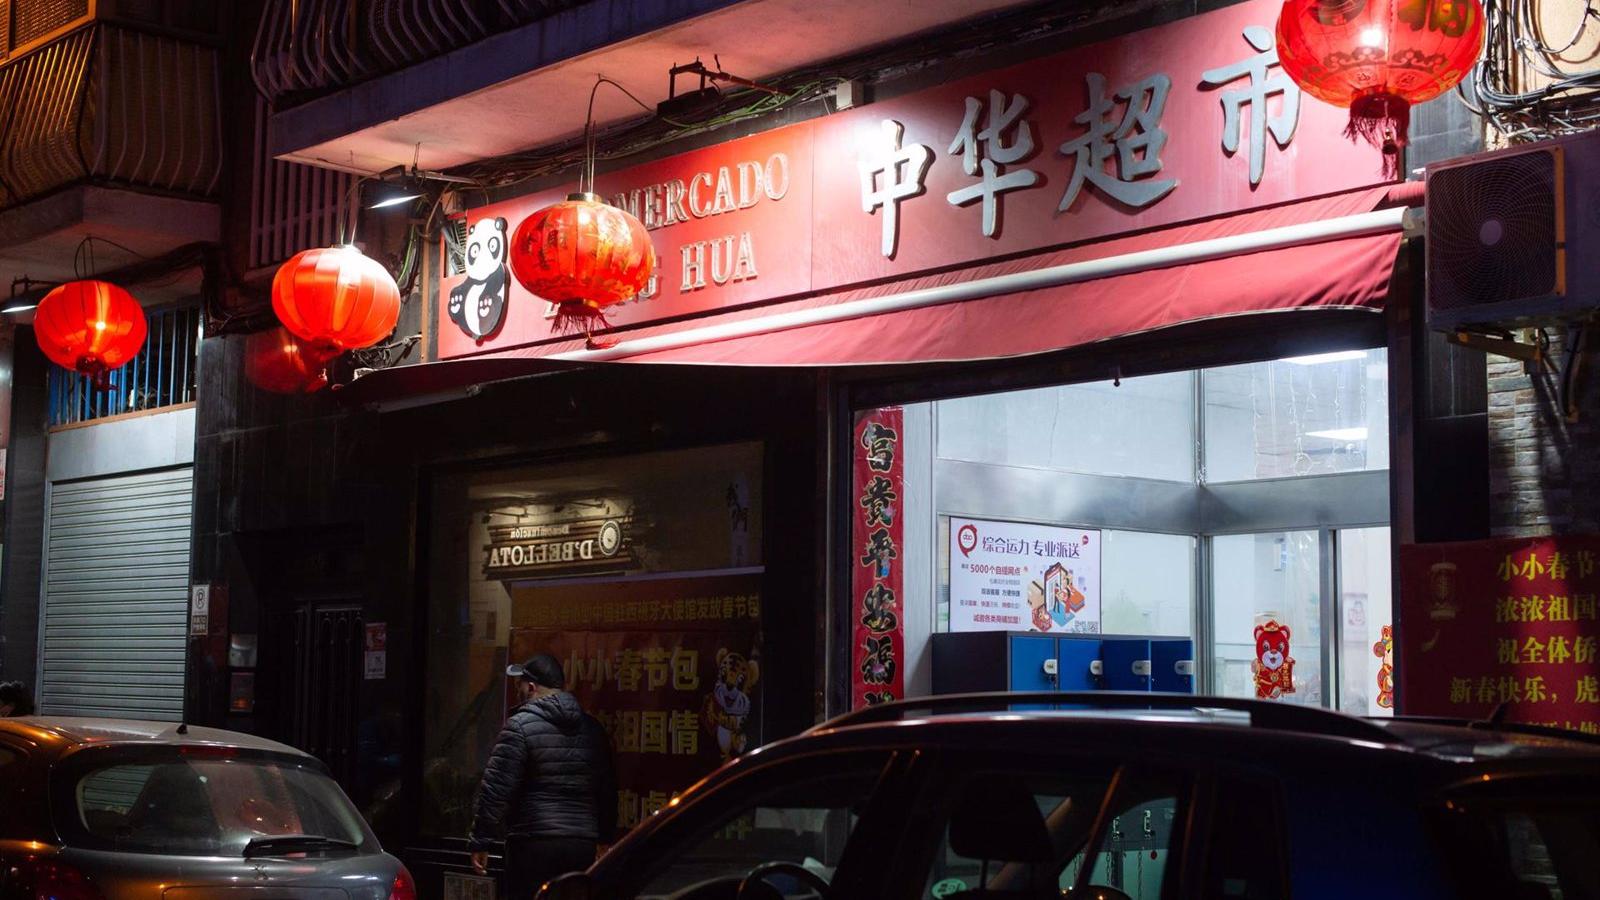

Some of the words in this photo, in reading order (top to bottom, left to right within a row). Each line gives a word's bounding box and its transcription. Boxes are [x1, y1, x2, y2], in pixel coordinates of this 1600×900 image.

[860, 26, 1301, 260] 中华超市
[607, 152, 790, 230] MERCADO
[680, 232, 757, 292] HUA
[982, 536, 1029, 555] 综合运力
[1033, 540, 1080, 559] 专业派送
[1496, 551, 1600, 582] 小小春节
[1496, 593, 1600, 623] 浓浓祖国
[1497, 635, 1600, 665] 祝全体侨
[563, 648, 700, 692] 小小春节包
